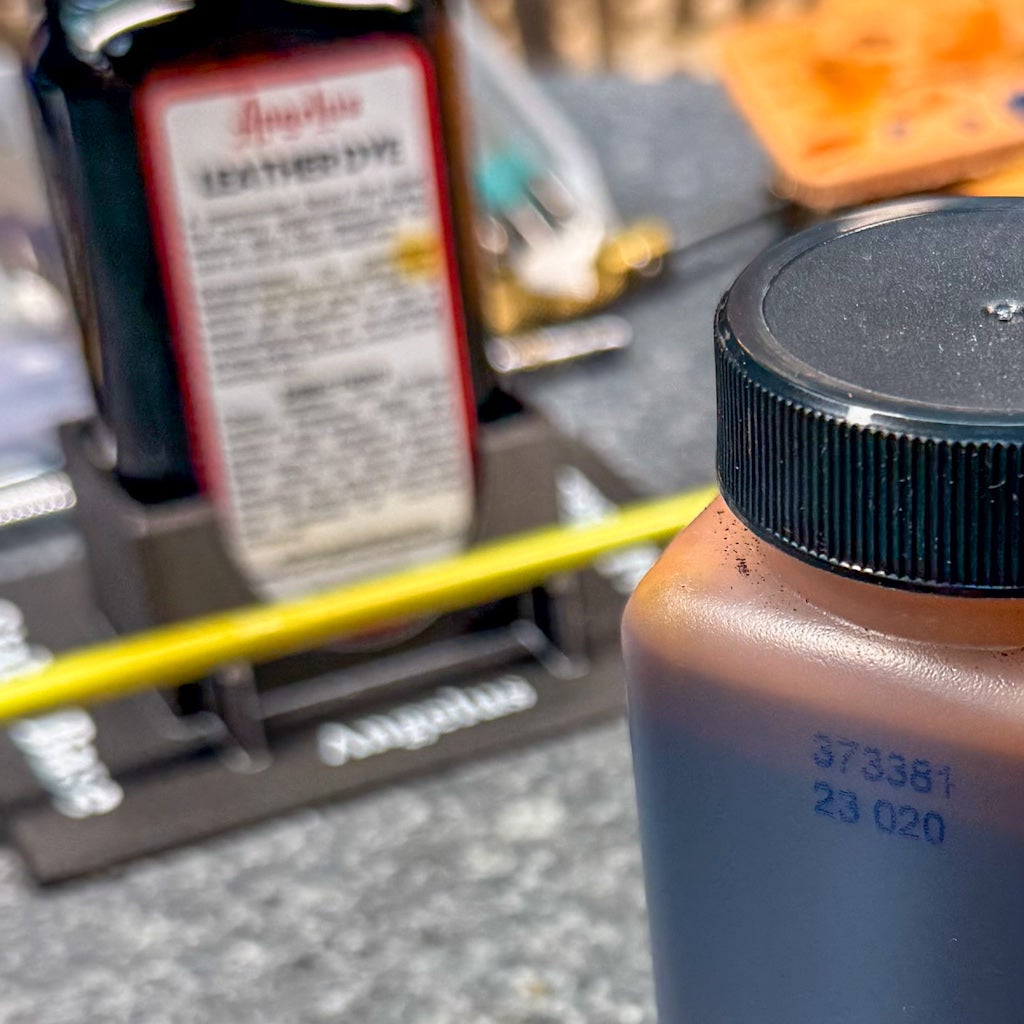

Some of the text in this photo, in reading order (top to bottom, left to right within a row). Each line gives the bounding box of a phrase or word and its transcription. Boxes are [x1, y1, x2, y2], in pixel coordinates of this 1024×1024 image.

[812, 731, 953, 799] 373381
[813, 780, 947, 846] 23 020
